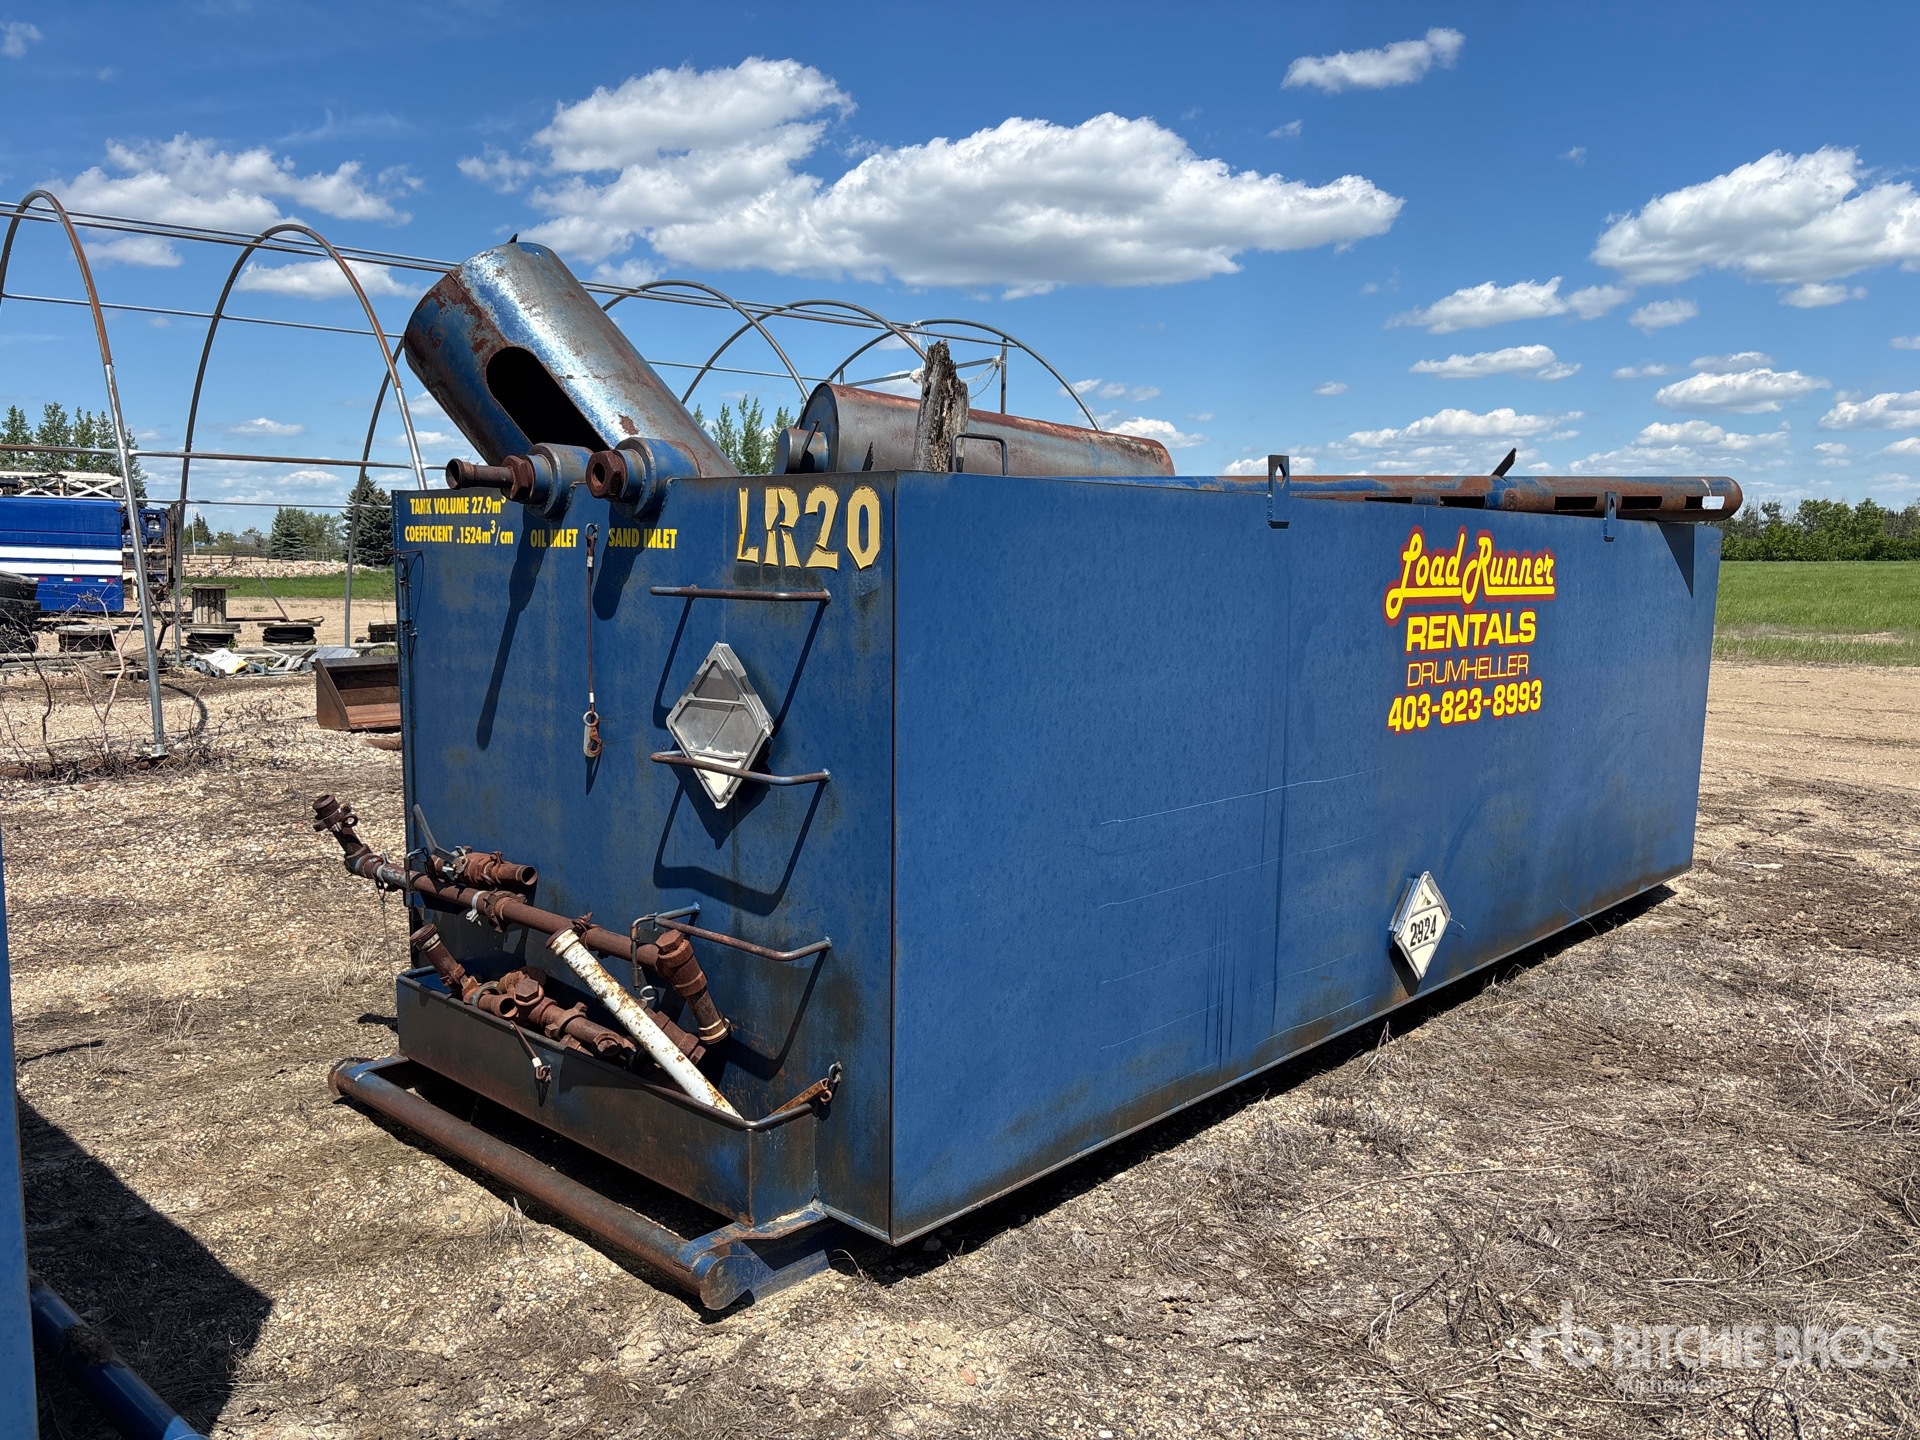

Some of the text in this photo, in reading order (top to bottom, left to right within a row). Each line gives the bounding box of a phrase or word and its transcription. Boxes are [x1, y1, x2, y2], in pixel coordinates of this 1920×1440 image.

[410, 498, 432, 514] TANK
[434, 497, 469, 514] VOLUME
[404, 525, 454, 542] COEFFICIENT
[530, 528, 579, 548] OIL INLET
[608, 527, 678, 549] SAND INLET
[736, 484, 883, 571] LR20
[1385, 532, 1555, 619] Load Runner
[1405, 611, 1537, 652] RENTALS
[1407, 654, 1529, 687] DRUMHELLER
[1387, 679, 1543, 732] 403-823-8993
[1409, 914, 1438, 948] 2924
